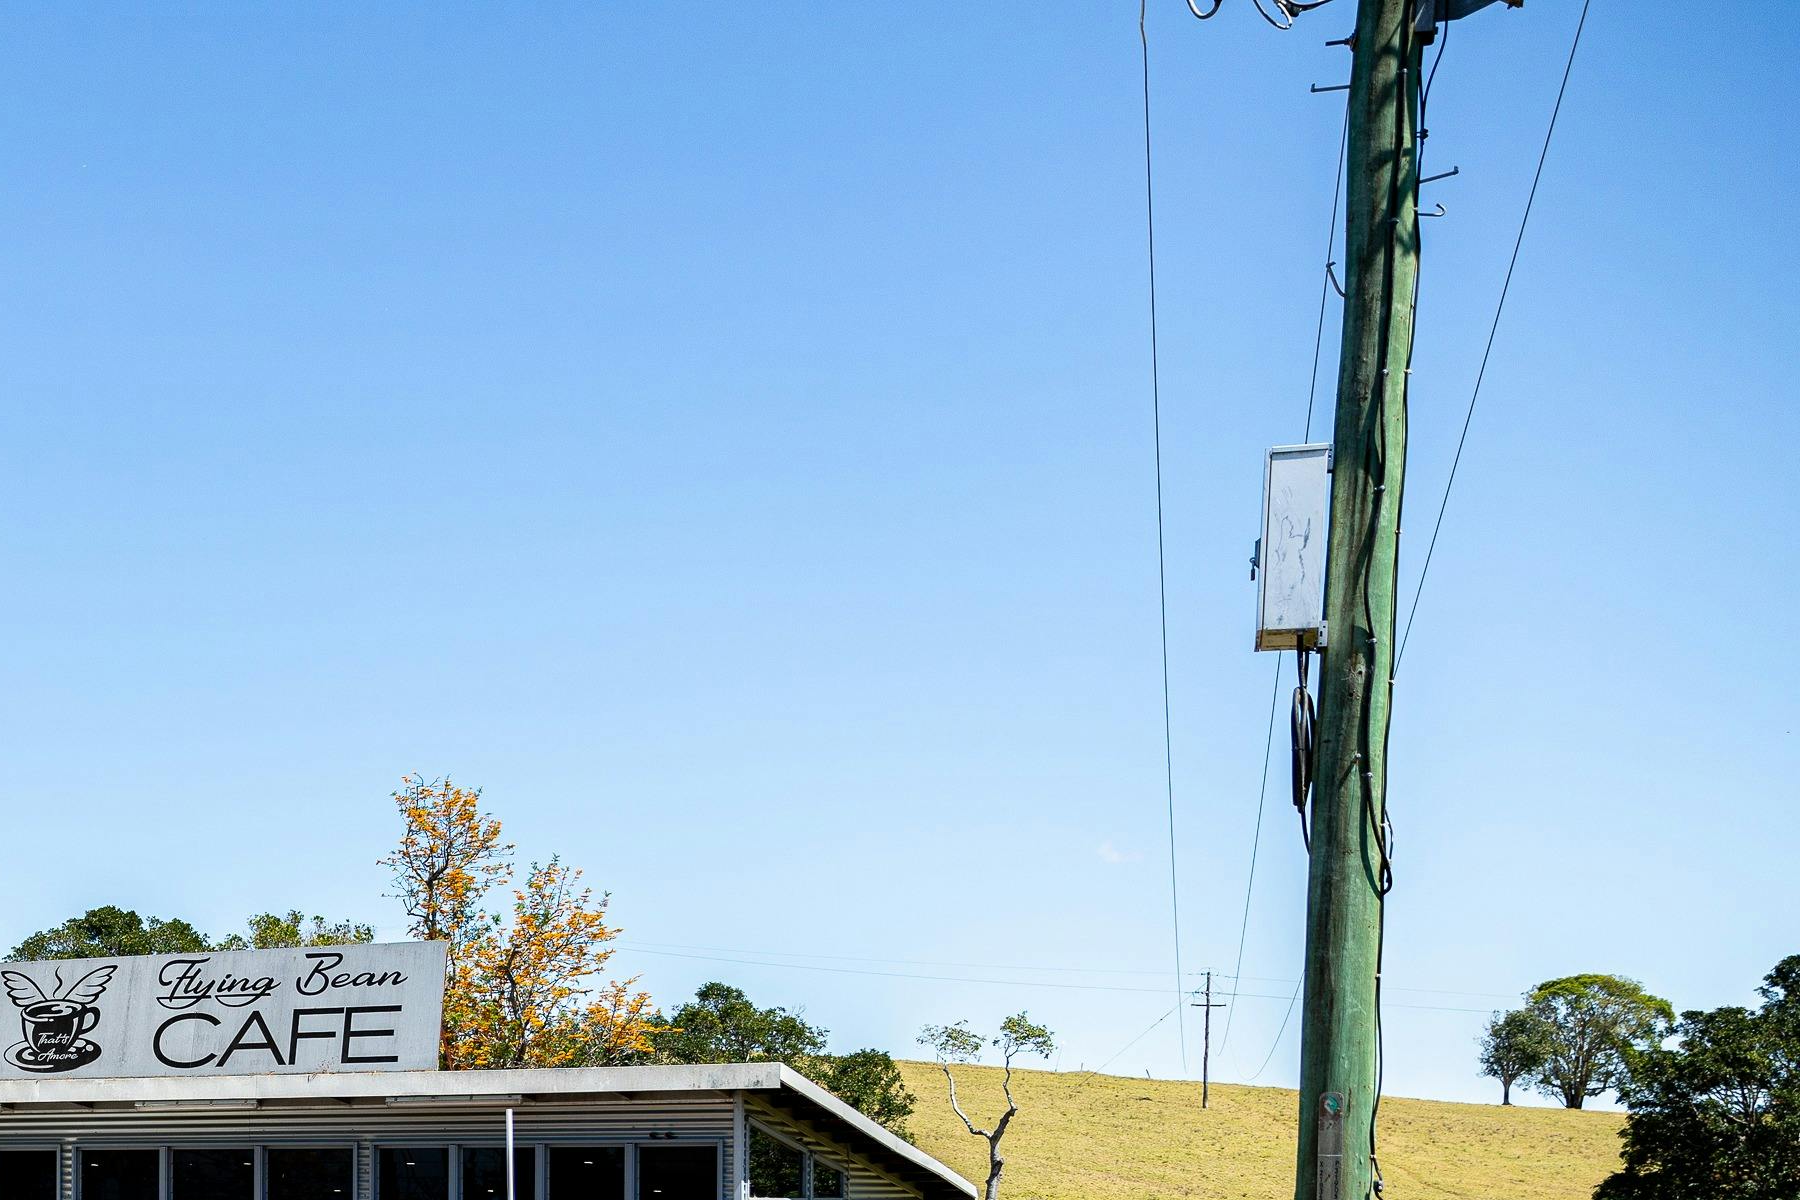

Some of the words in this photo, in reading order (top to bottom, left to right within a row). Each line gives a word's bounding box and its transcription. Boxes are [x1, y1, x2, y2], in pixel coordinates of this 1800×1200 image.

[156, 957, 281, 1009] Flying
[296, 952, 408, 996] Bean
[37, 1047, 79, 1062] Amore
[38, 1032, 69, 1047] That's
[153, 1005, 402, 1069] CAFE
